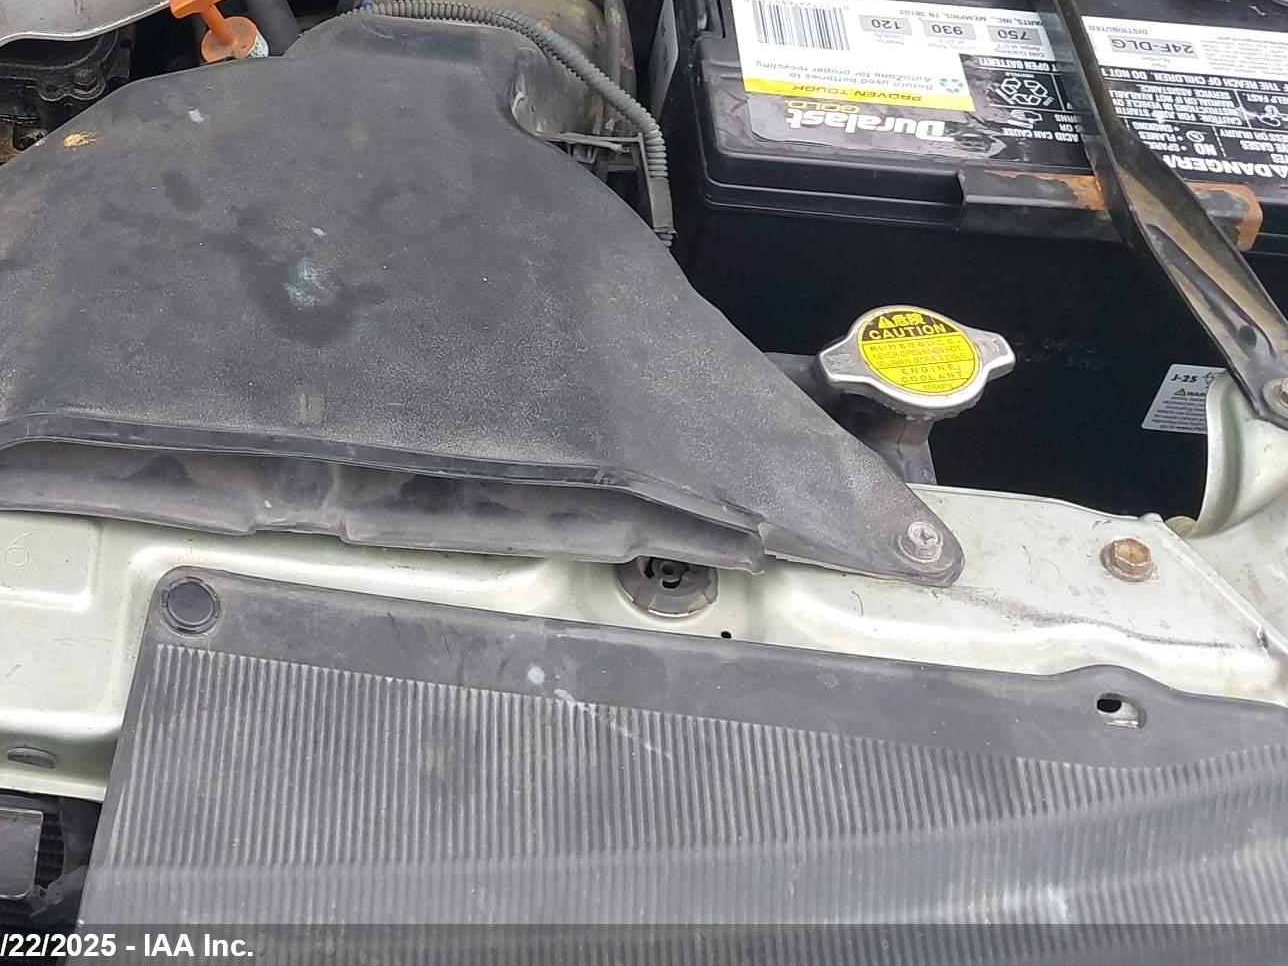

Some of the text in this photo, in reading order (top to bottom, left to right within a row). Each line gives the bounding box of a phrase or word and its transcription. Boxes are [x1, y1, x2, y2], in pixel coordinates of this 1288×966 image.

[871, 19, 900, 30] 120
[931, 24, 964, 36] 930
[1088, 24, 1149, 35] DISTRIBUTED
[997, 29, 1032, 41] 750
[1110, 38, 1195, 54] 24F-DLG
[755, 59, 933, 83] AutoZone for proper recycling
[1024, 59, 1050, 72] OPEN
[1109, 68, 1131, 79] NOT
[1131, 70, 1148, 80] DO
[788, 72, 934, 91] Return used batteries to
[1206, 76, 1222, 86] OF
[1222, 77, 1259, 91] REACH
[1257, 80, 1281, 92] THE
[792, 84, 922, 102] PROVEN TOUGH
[1242, 93, 1270, 103] FAST.
[788, 100, 860, 114] GOLD
[1125, 99, 1163, 110] VEHICLE
[1176, 112, 1197, 121] FOR
[785, 108, 955, 143] Duralast
[1058, 123, 1074, 132] OR
[1132, 121, 1174, 133] SMOKING
[1001, 127, 1079, 142] ACID CAN CAUSE
[1138, 130, 1177, 142] FLAMES
[1142, 140, 1180, 152] SPARK
[1193, 143, 1218, 156] NO
[1239, 139, 1275, 152] GASES
[891, 313, 926, 327] 危険
[868, 324, 947, 340] CAUTION
[901, 363, 954, 375] ENGINE
[901, 371, 962, 384] COOLANT
[1170, 373, 1199, 383] J-25
